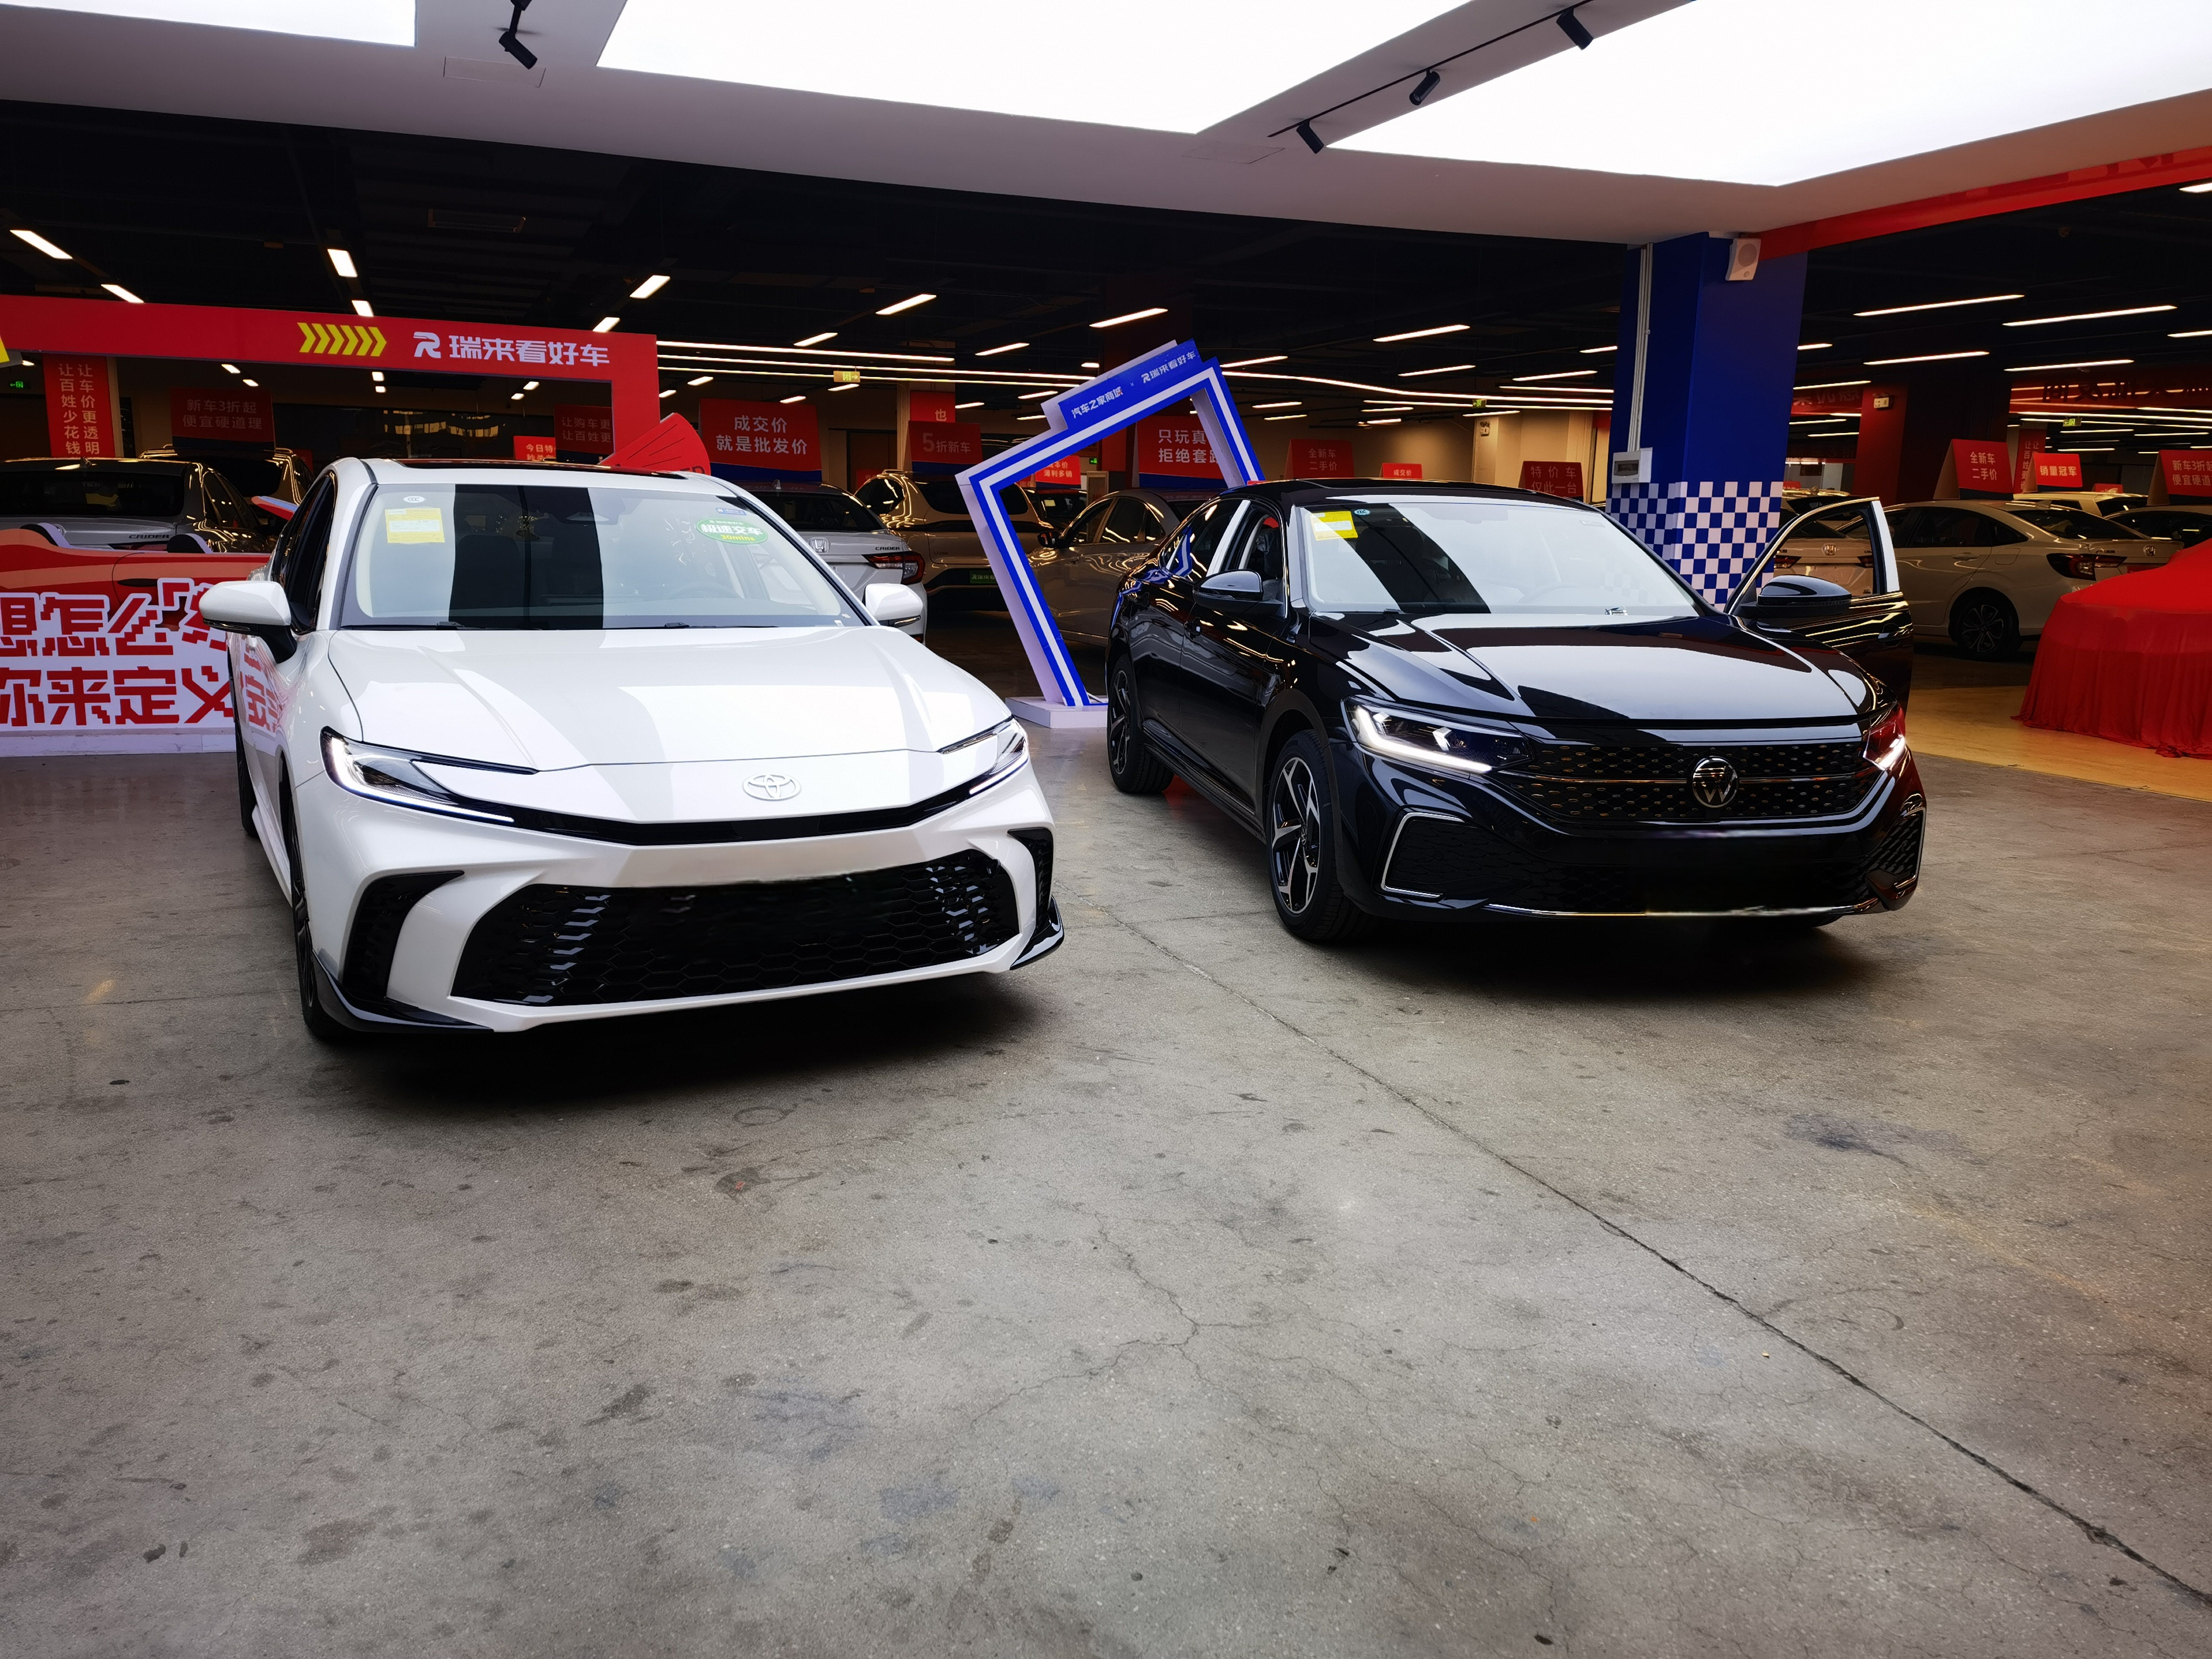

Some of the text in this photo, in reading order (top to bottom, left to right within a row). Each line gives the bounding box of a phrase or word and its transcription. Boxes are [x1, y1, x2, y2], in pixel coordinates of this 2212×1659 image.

[449, 335, 610, 367] 瑞来看好车
[1071, 386, 1123, 419] 汽车之家商城
[1149, 351, 1196, 380] 瑞来看好车
[58, 363, 81, 455] 让百姓少花钱
[78, 363, 100, 455] 让车价更透明
[186, 399, 257, 414] 新车3折起
[935, 408, 947, 422] 也
[183, 414, 263, 430] 便宜硬道理
[561, 416, 611, 429] 让购车更
[734, 415, 787, 433] 成交价
[562, 430, 611, 442] 让百姓更
[525, 443, 555, 454] 今日特
[716, 434, 807, 455] 就是批发价
[922, 433, 972, 453] 5折新车
[1308, 448, 1337, 458] 全新车
[1970, 451, 1996, 465] 全新车
[1309, 461, 1338, 471] 二手价
[1530, 466, 1577, 479] 特价车
[2039, 465, 2078, 477] 销量冠军
[1972, 468, 1998, 481] 二手价
[2172, 474, 2212, 486] 便宜硬道
[1531, 481, 1577, 494] 仅此一台
[701, 523, 763, 535] 极速交车
